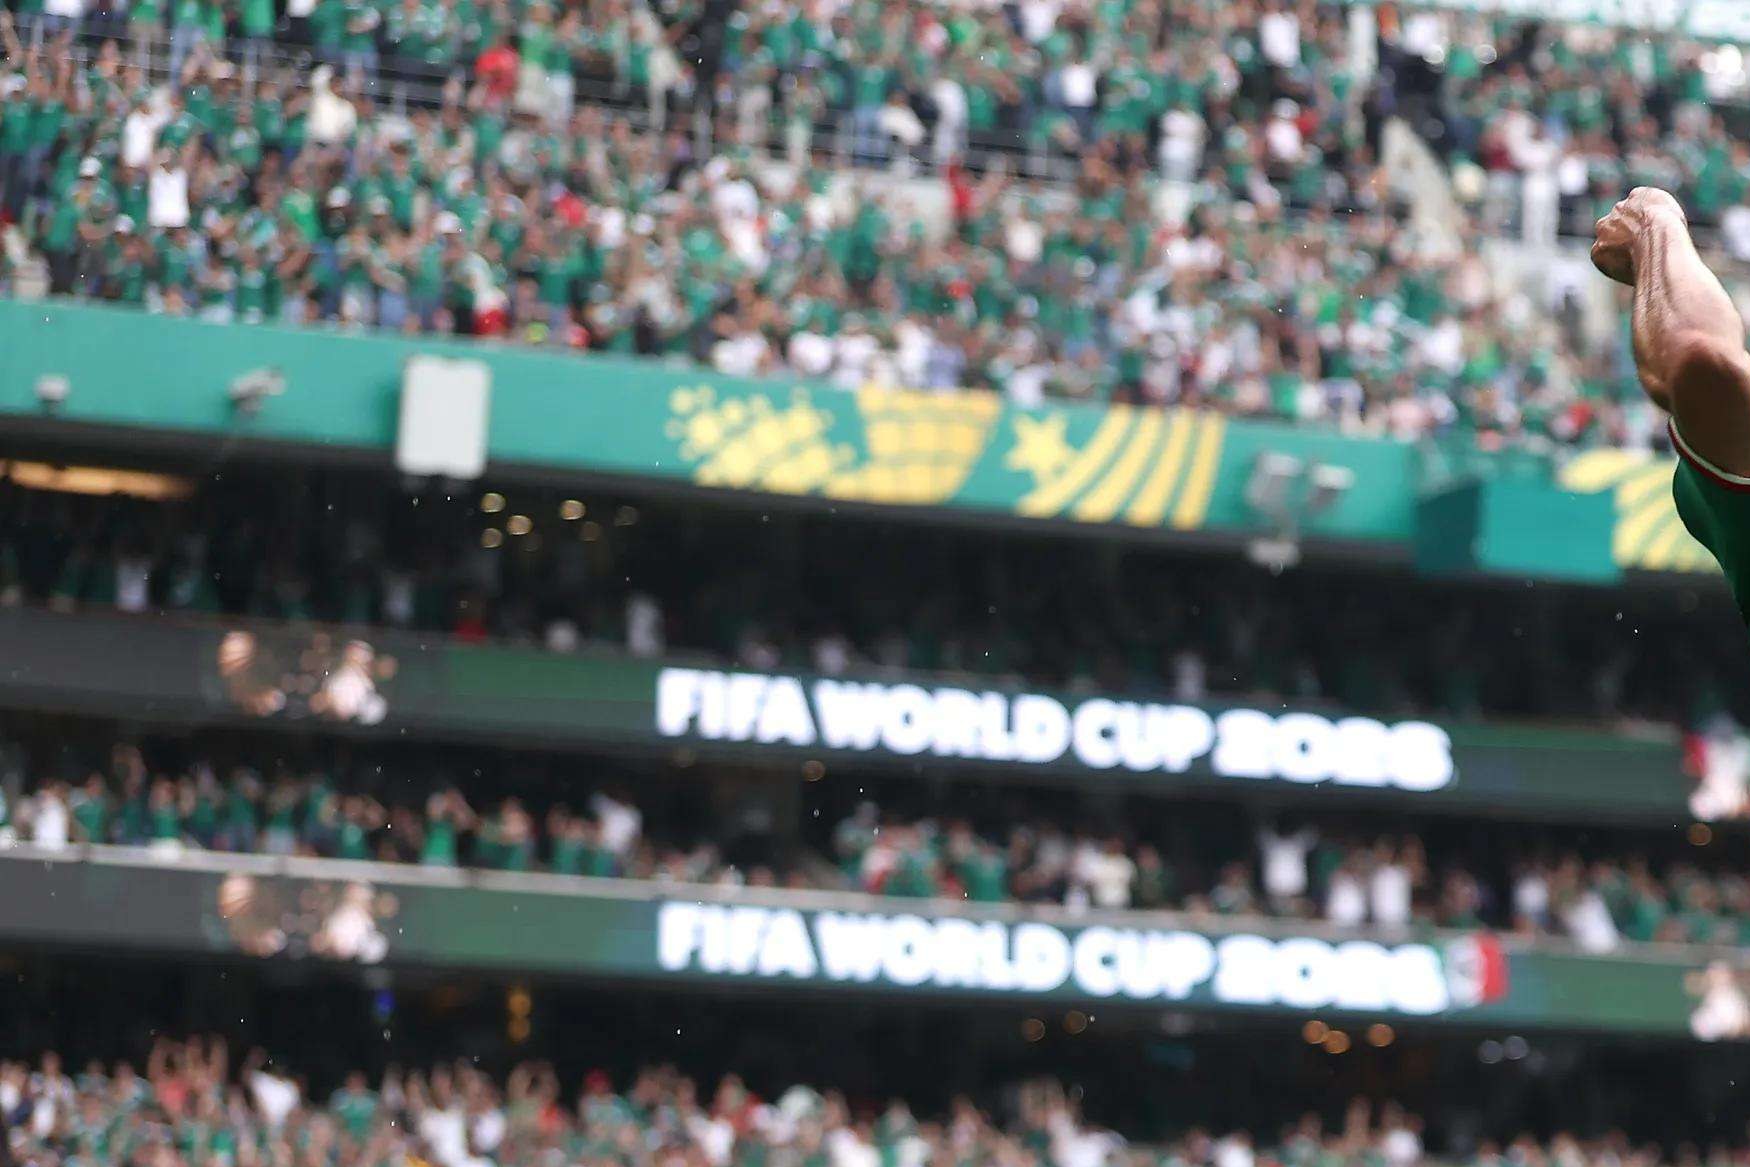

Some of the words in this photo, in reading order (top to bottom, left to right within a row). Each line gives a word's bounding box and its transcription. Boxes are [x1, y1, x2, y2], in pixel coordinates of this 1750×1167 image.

[657, 667, 816, 746] FIFA
[814, 679, 1073, 764] WORLD
[1072, 698, 1216, 774] CUP
[658, 902, 817, 979] FIFA
[815, 911, 1073, 992] WORLD
[1072, 926, 1216, 999] CUP
